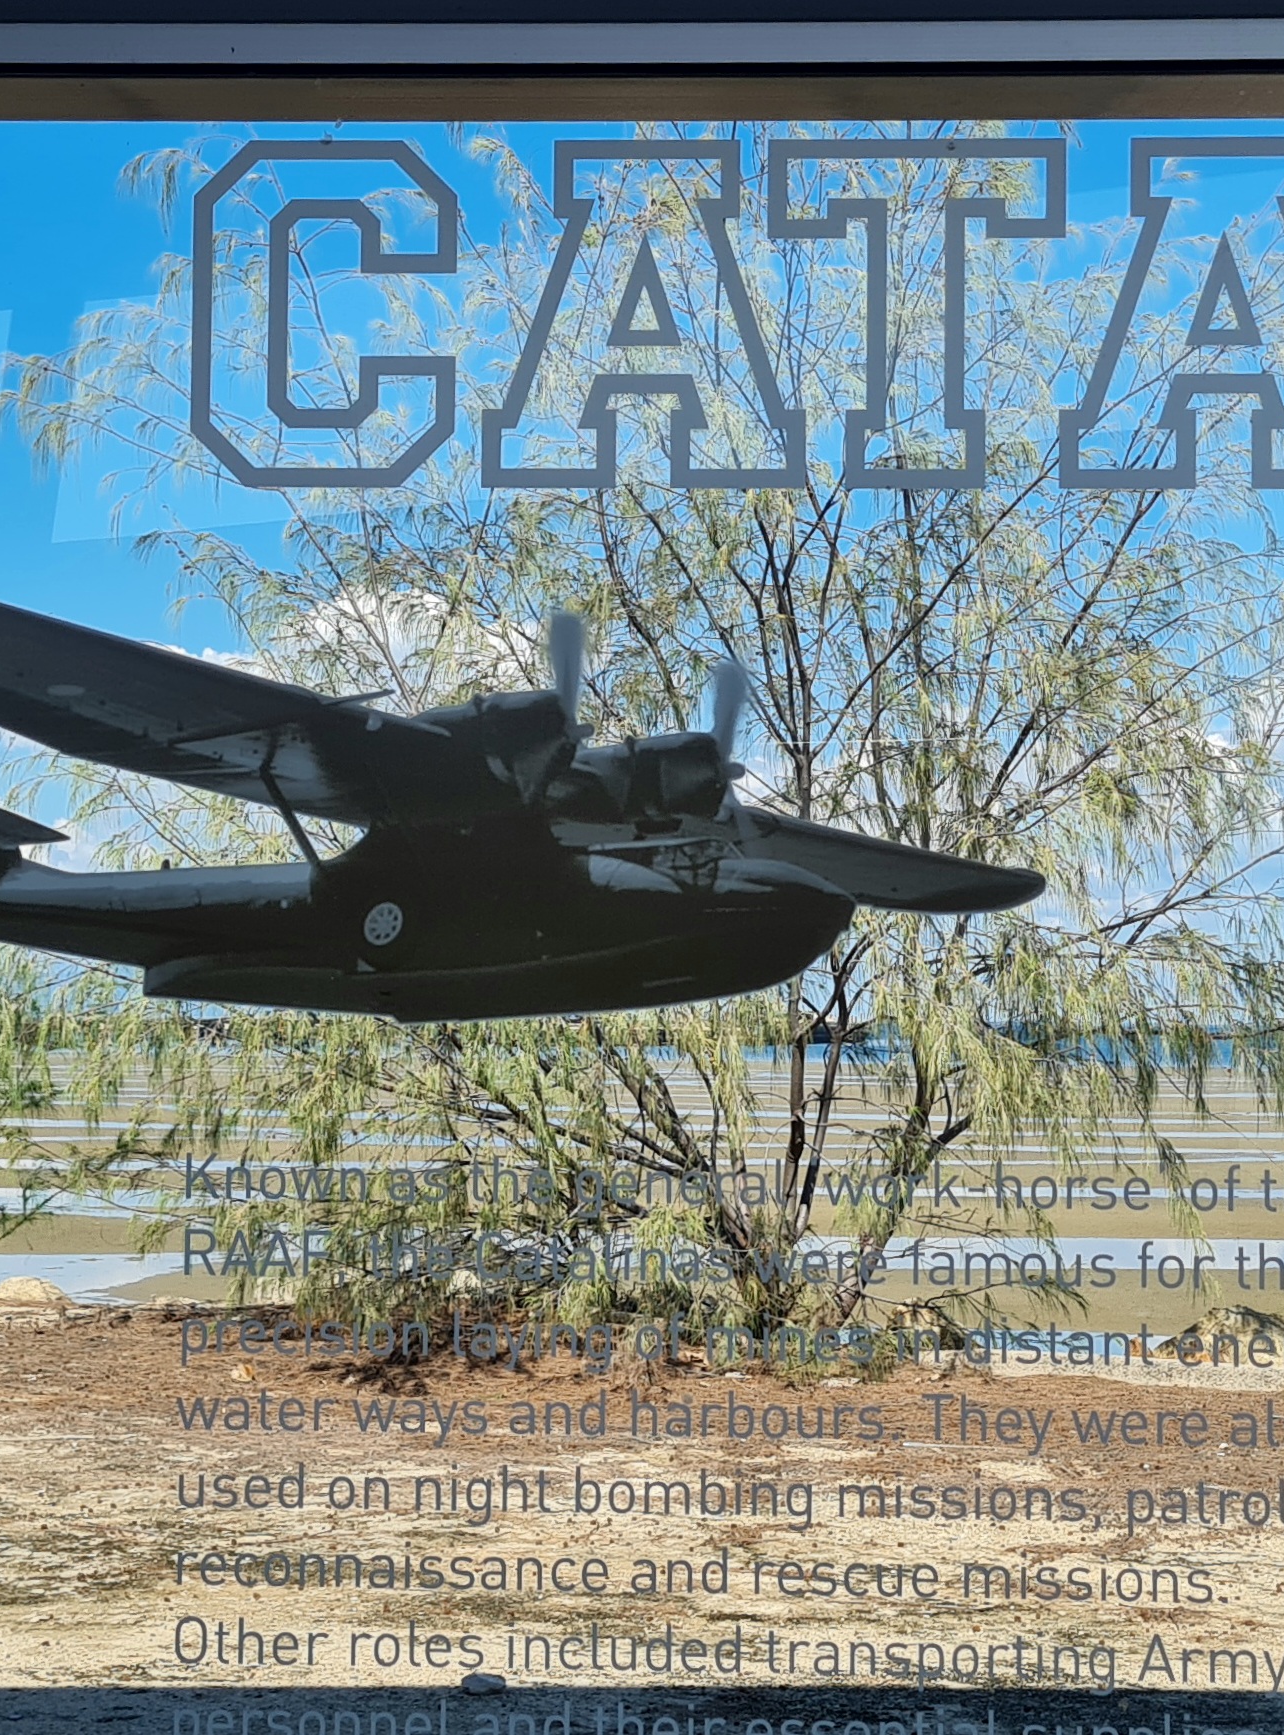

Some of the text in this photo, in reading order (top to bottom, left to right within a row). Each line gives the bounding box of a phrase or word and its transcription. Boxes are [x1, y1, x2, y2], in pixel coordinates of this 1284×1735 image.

[185, 1152, 368, 1202] Known
[388, 1166, 450, 1203] as
[472, 1156, 554, 1203] the
[576, 1158, 784, 1220] general
[1191, 1164, 1240, 1212] of
[184, 1228, 345, 1284] RAAF,
[369, 1232, 453, 1280] the
[475, 1231, 737, 1285] Catalinas
[756, 1250, 887, 1286] were
[913, 1239, 1115, 1289] famous
[1140, 1241, 1215, 1291] for
[180, 1307, 428, 1366] precision
[452, 1310, 614, 1374] laying
[636, 1311, 685, 1361] of
[706, 1314, 874, 1364] mines
[897, 1317, 941, 1365] in
[964, 1319, 1156, 1367] distant
[176, 1388, 338, 1434] water
[353, 1398, 488, 1446] ways
[509, 1388, 606, 1436] and
[631, 1389, 899, 1442] harbours.
[922, 1393, 1053, 1456] They
[1071, 1411, 1207, 1446] were
[177, 1462, 306, 1509] used
[328, 1473, 390, 1511] on
[416, 1463, 552, 1526] night
[575, 1466, 814, 1531] bombing
[839, 1472, 1102, 1530] missions,
[175, 1543, 1229, 1604] reconnaissance and rescue missions.
[174, 1615, 328, 1667] Other
[350, 1619, 484, 1669] roles
[507, 1622, 742, 1674] included
[766, 1629, 1115, 1695] transporting
[172, 1699, 447, 1735] personnel
